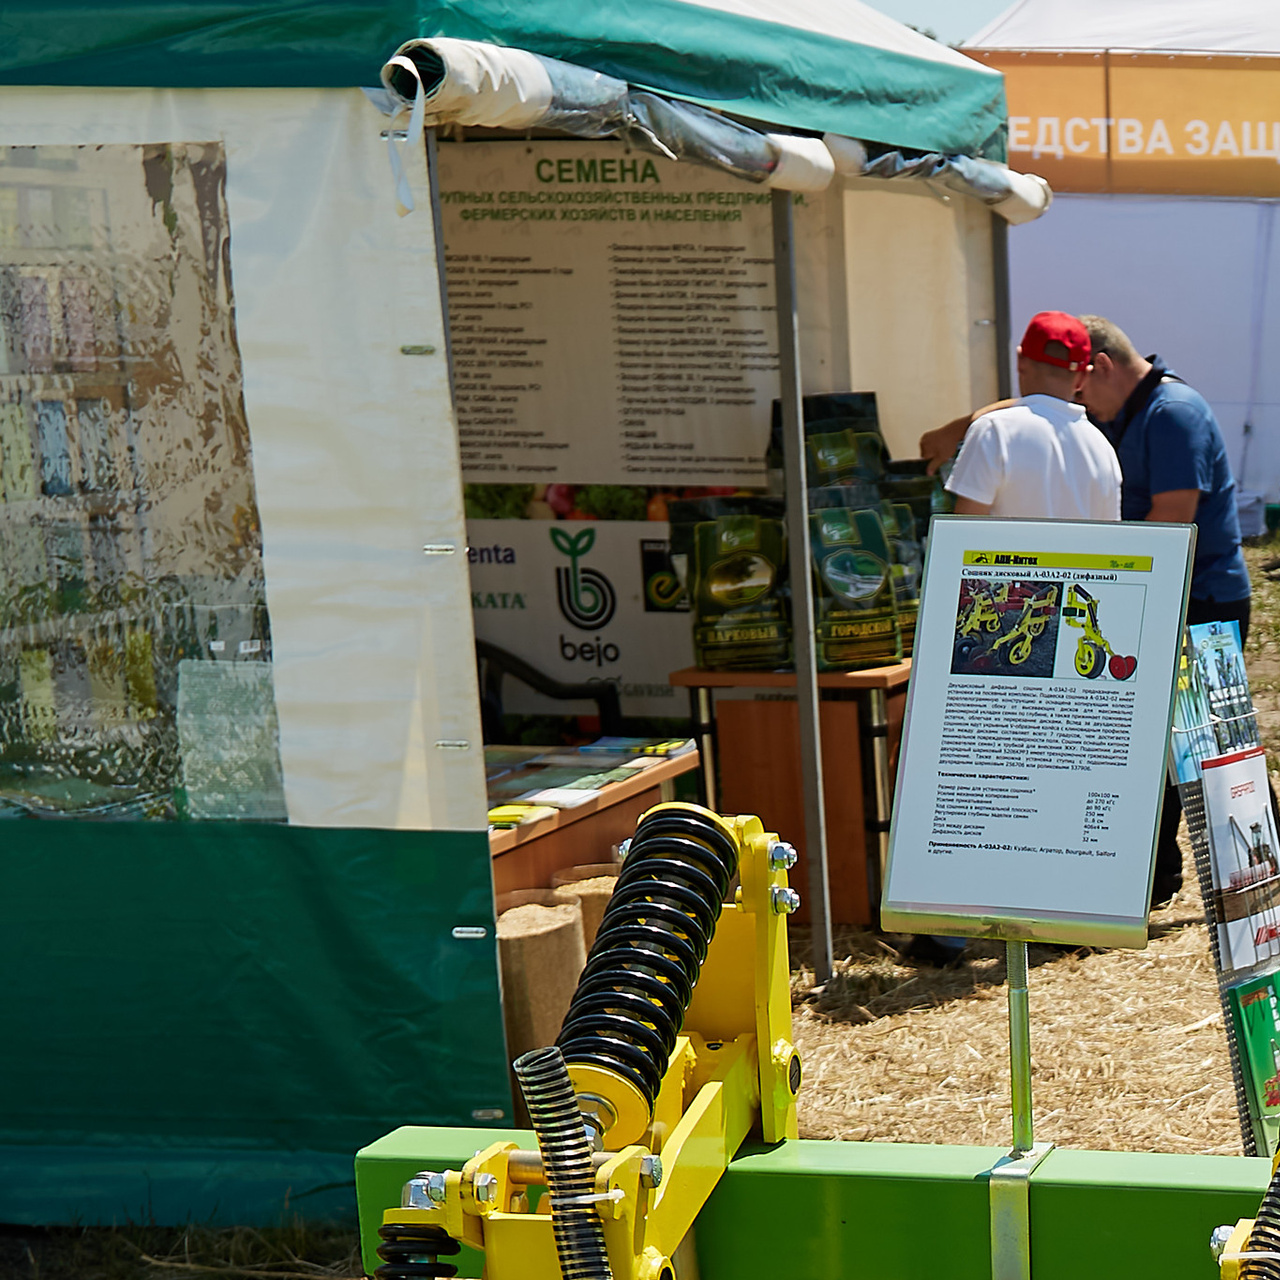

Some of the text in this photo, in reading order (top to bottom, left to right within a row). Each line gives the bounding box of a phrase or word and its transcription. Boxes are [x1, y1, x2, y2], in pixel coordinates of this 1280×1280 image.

[536, 158, 660, 184] СЕМЕНА
[498, 190, 692, 205] СЕЛЬСКОХОЗЯЙСТВЕННЫХ
[460, 206, 742, 222] ФЕРМЕРСКИХ ХОЗЯЙСТВ И НАСЕЛЕНИЯ
[559, 634, 621, 666] bejo
